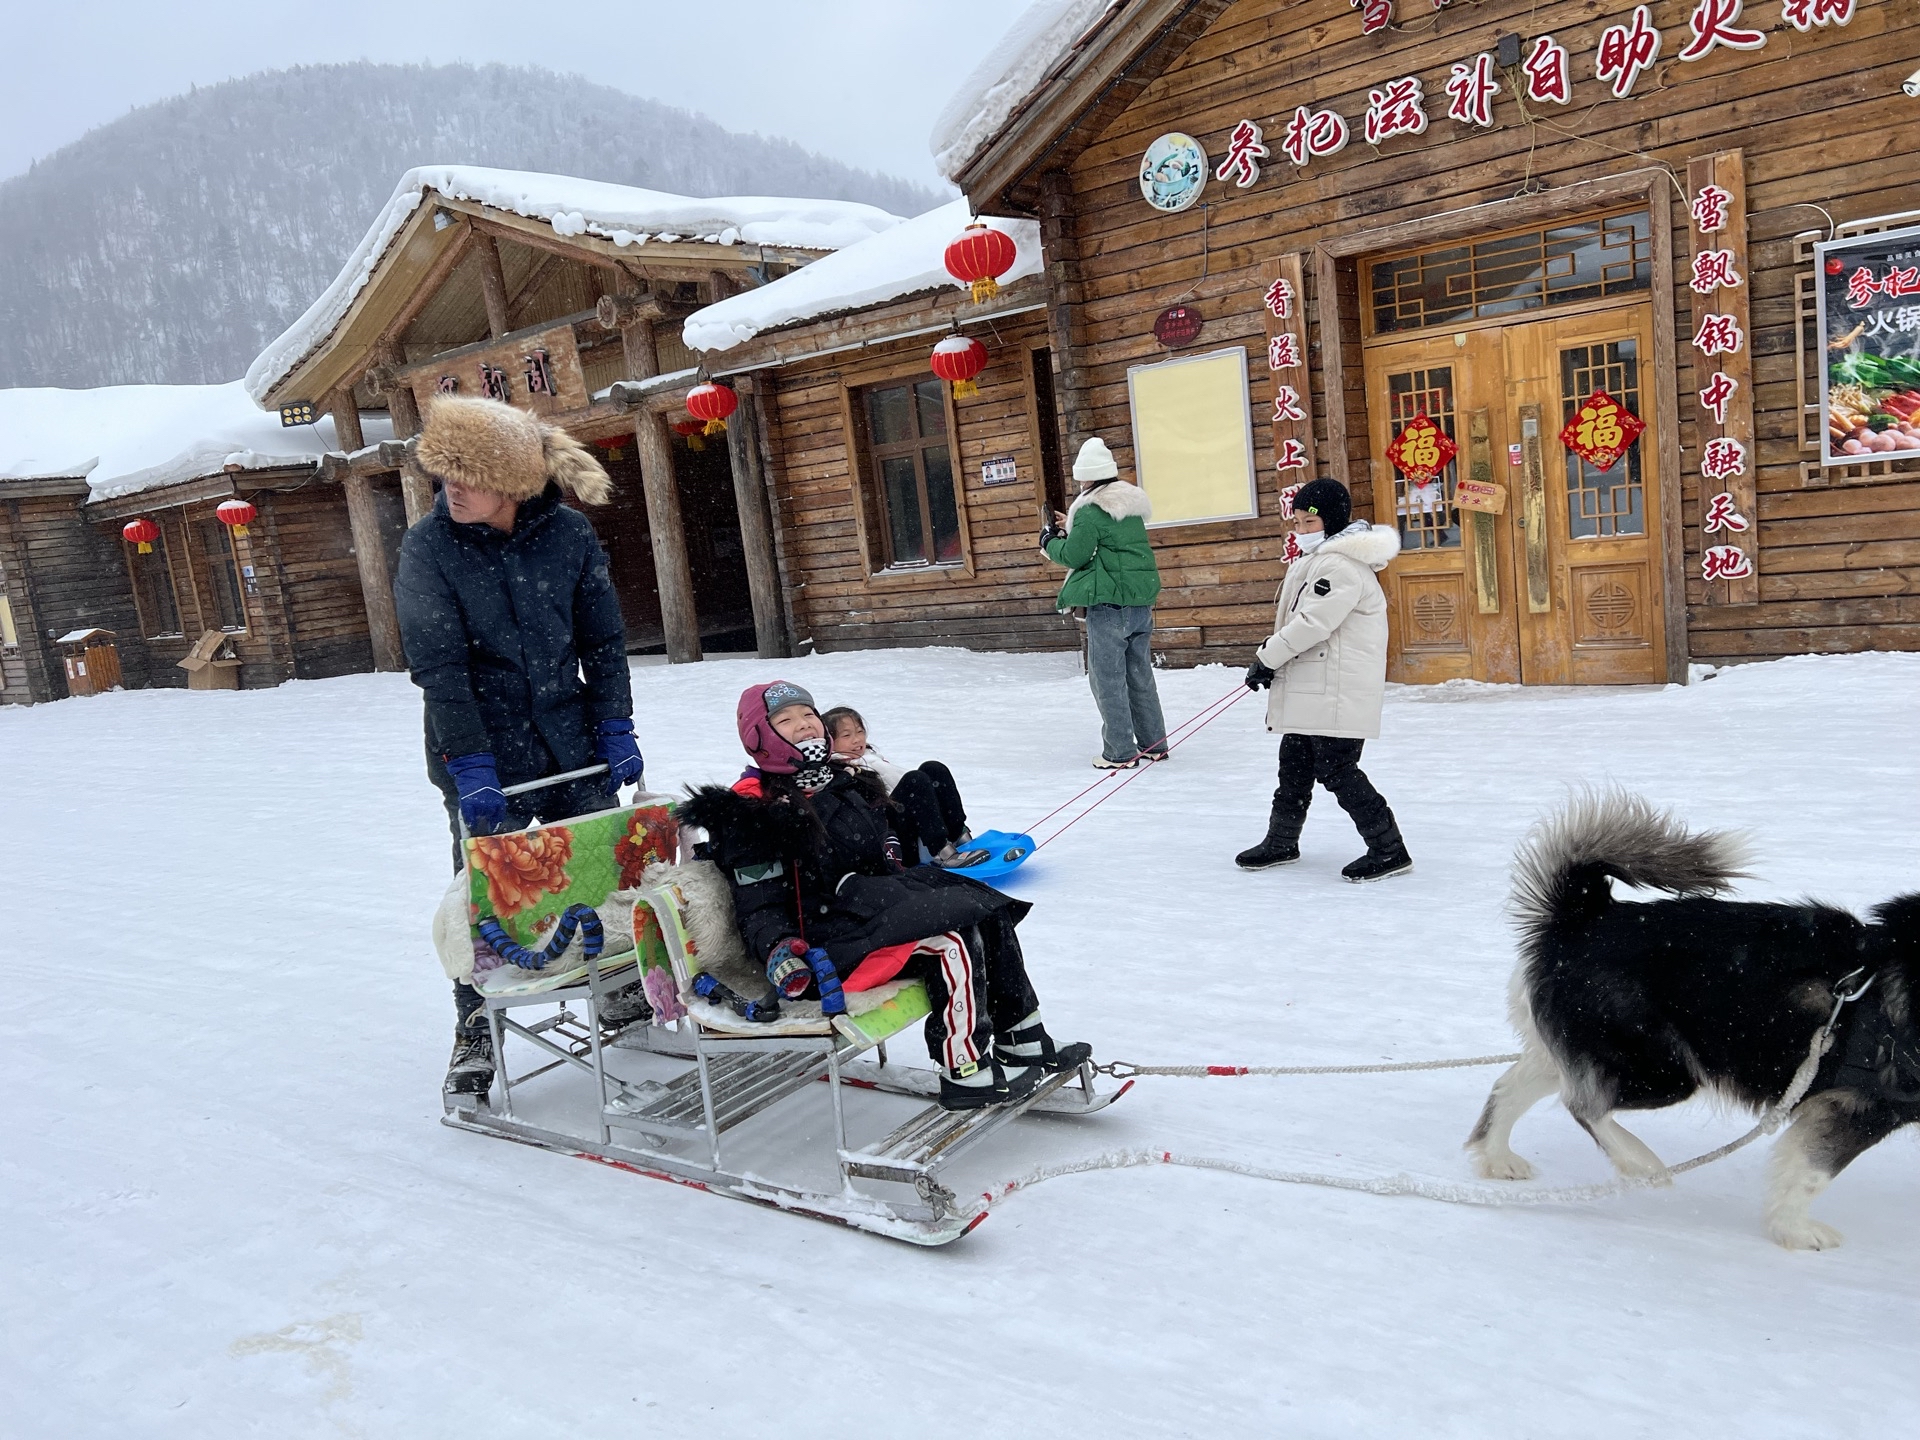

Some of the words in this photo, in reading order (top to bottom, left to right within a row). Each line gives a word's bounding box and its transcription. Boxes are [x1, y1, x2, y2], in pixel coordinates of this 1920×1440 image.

[1866, 305, 1920, 337] 火锅
[1690, 184, 1753, 581] 雪飘锅中融天地
[1400, 426, 1440, 468] 福
[1576, 404, 1624, 450] 福
